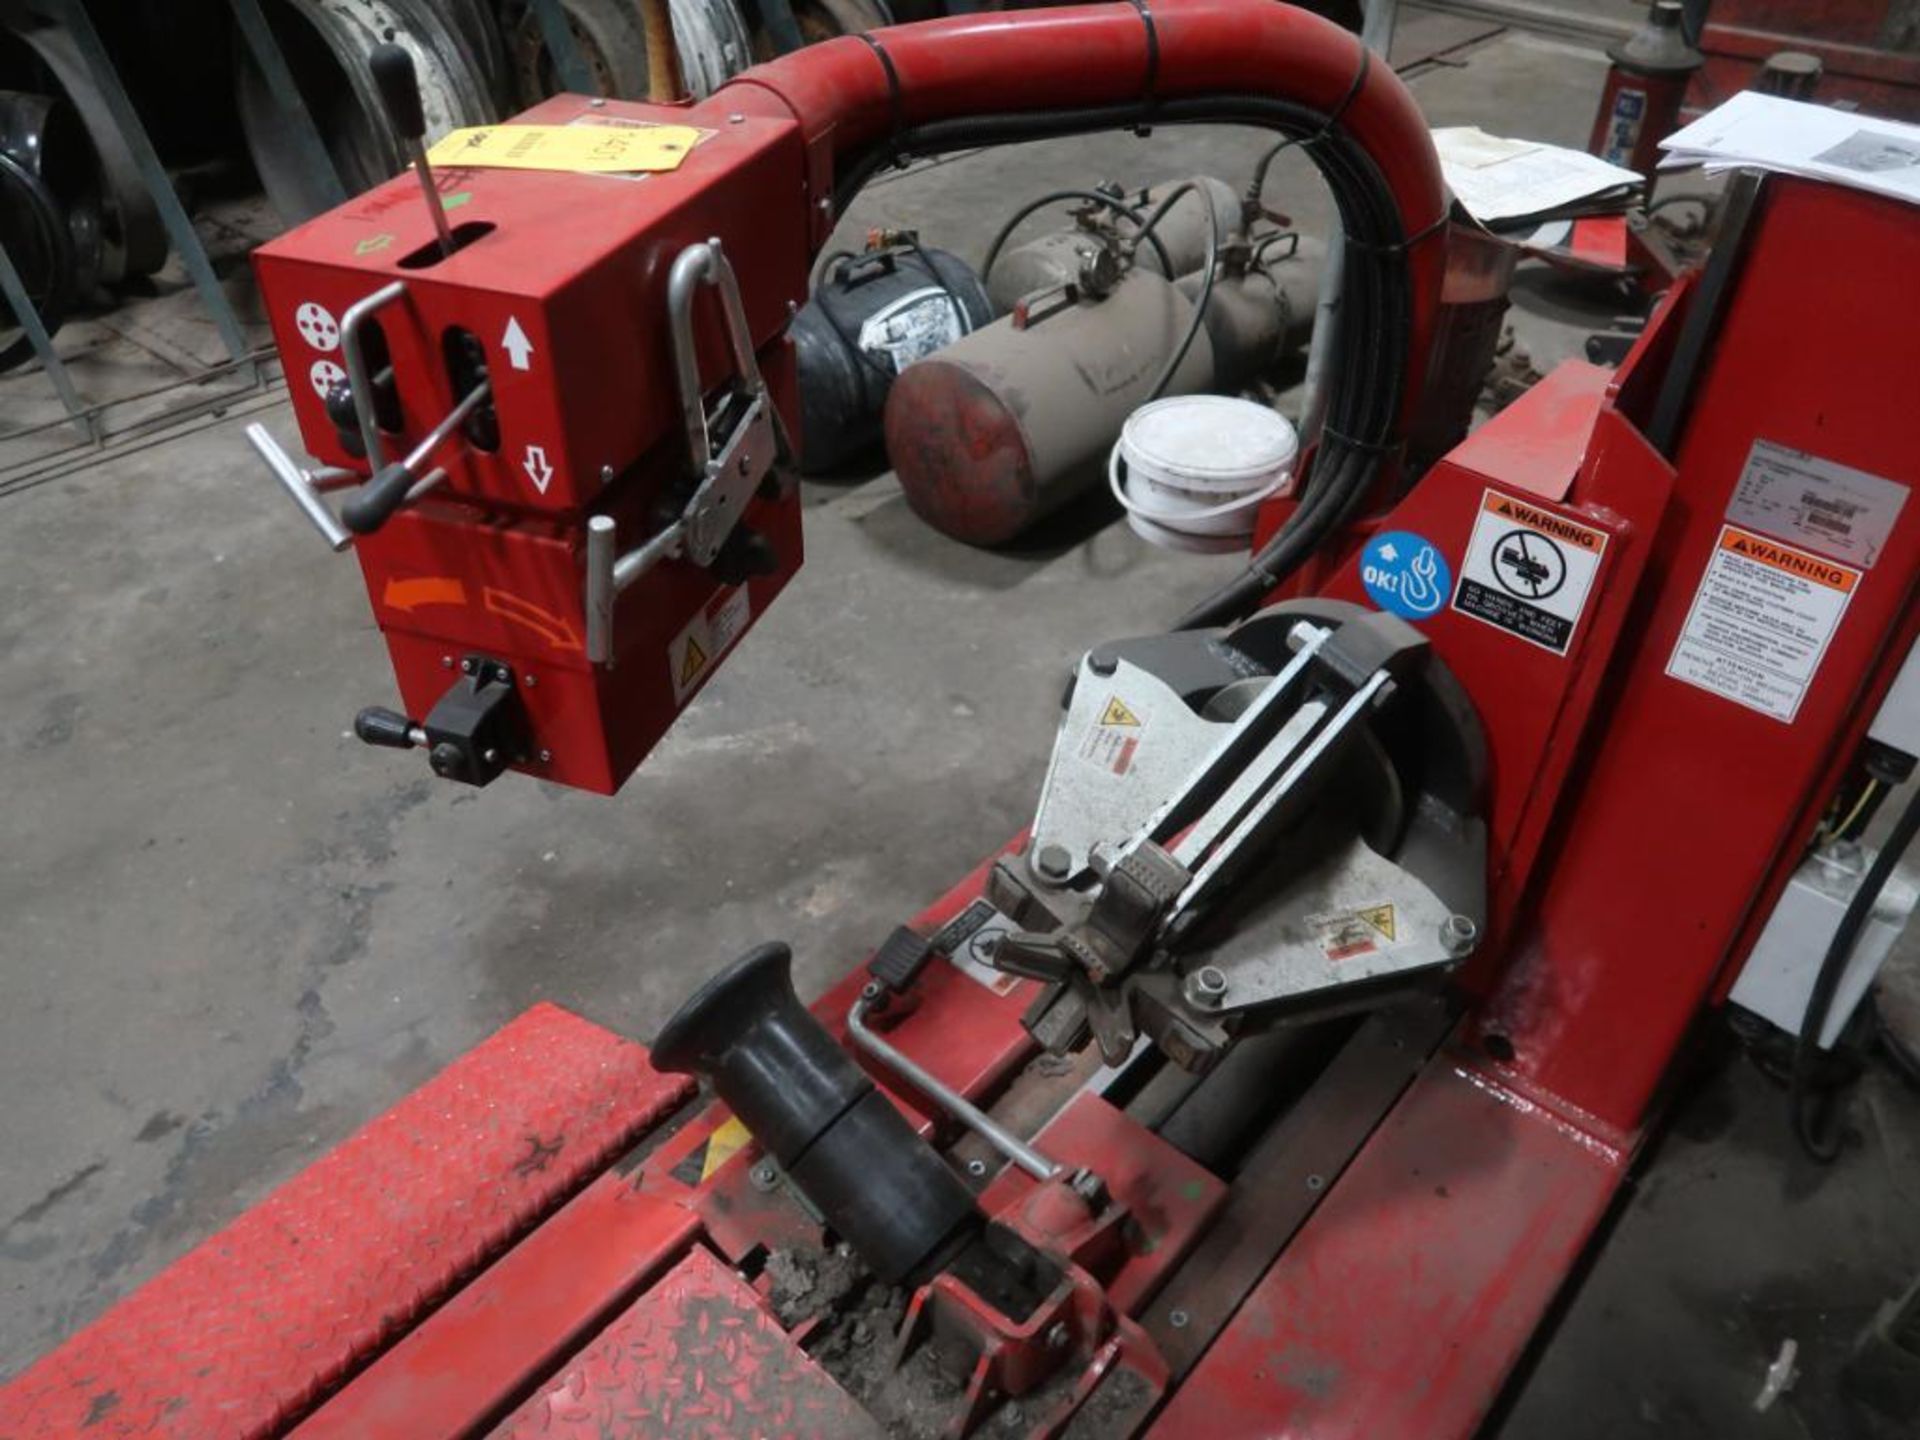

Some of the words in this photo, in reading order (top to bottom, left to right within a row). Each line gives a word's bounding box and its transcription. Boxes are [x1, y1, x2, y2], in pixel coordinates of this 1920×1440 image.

[1515, 506, 1594, 547] WARNING
[1363, 566, 1398, 592] OK!
[1750, 543, 1844, 585] WARNING
